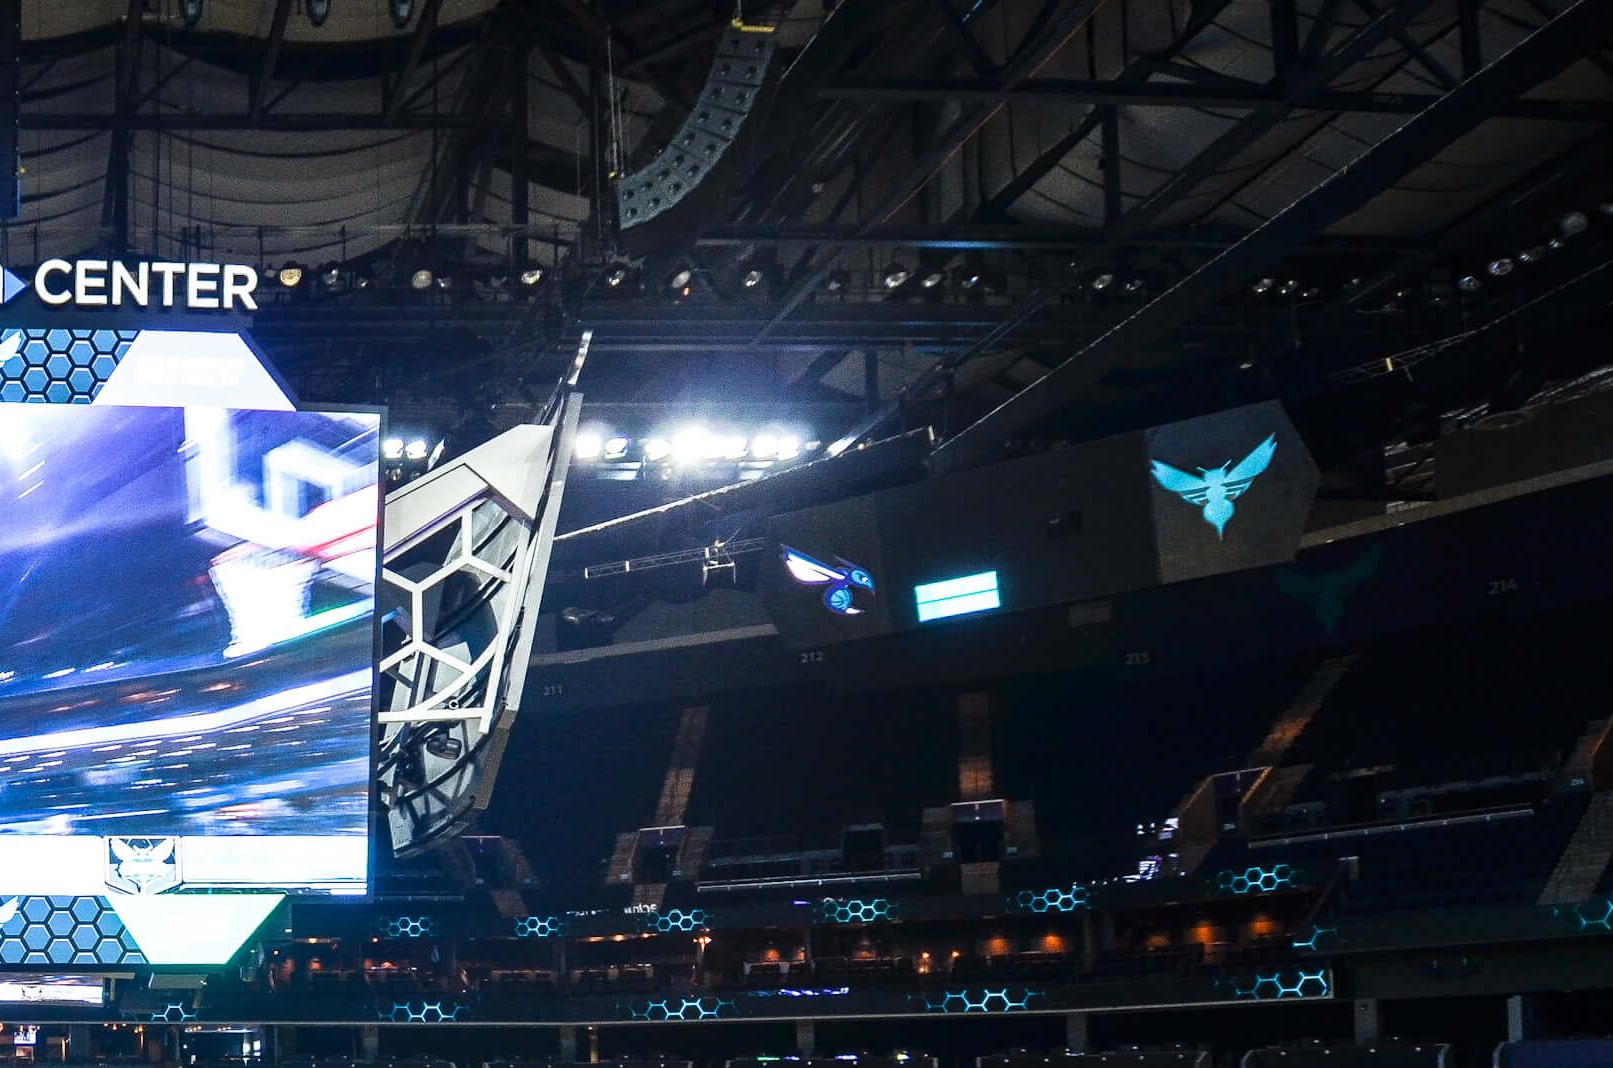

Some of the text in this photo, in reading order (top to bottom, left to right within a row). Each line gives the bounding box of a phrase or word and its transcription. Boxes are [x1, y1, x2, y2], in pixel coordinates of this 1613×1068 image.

[35, 258, 258, 310] CENTER
[1488, 578, 1517, 596] 214
[800, 651, 824, 664] 212
[1124, 651, 1150, 665] 213
